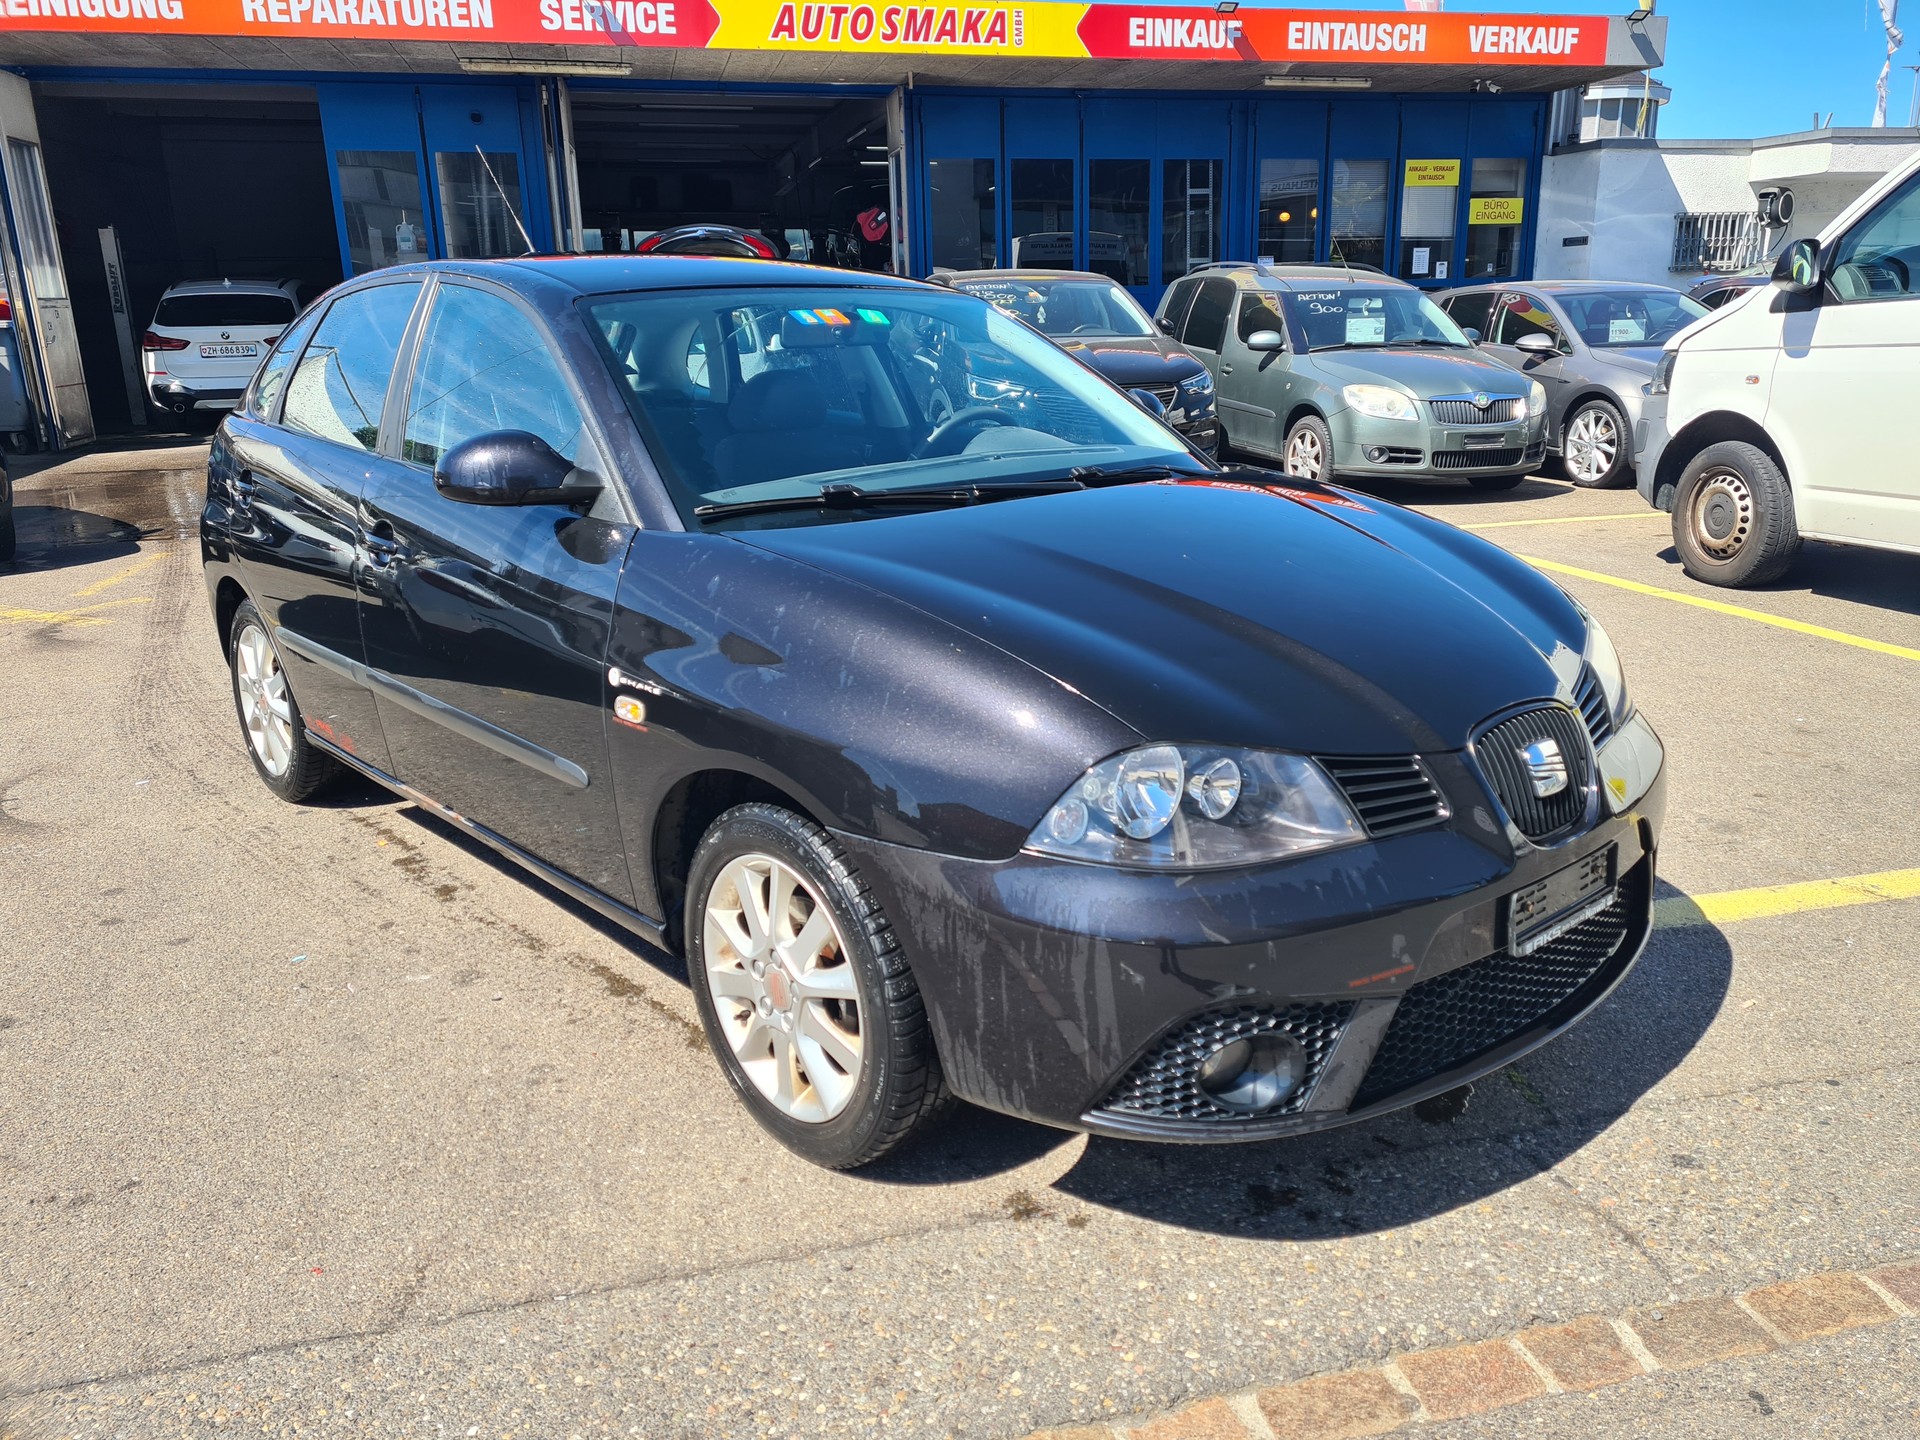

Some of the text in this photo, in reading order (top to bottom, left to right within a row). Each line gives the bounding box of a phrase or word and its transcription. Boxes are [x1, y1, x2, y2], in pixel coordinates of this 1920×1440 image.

[0, 0, 184, 19] EINIGUNG
[243, 0, 494, 28] REPARATUREN
[540, 0, 677, 34] SERVICE
[770, 3, 1023, 47] AUTO SMAKA GMBH
[1129, 17, 1243, 48] EINKAUF
[1288, 21, 1427, 51] EINTAUSCH
[1468, 25, 1580, 54] VERKAUF
[1475, 211, 1515, 220] EINGANG
[1483, 200, 1509, 210] BÜRO
[1297, 291, 1341, 302] AKTION!
